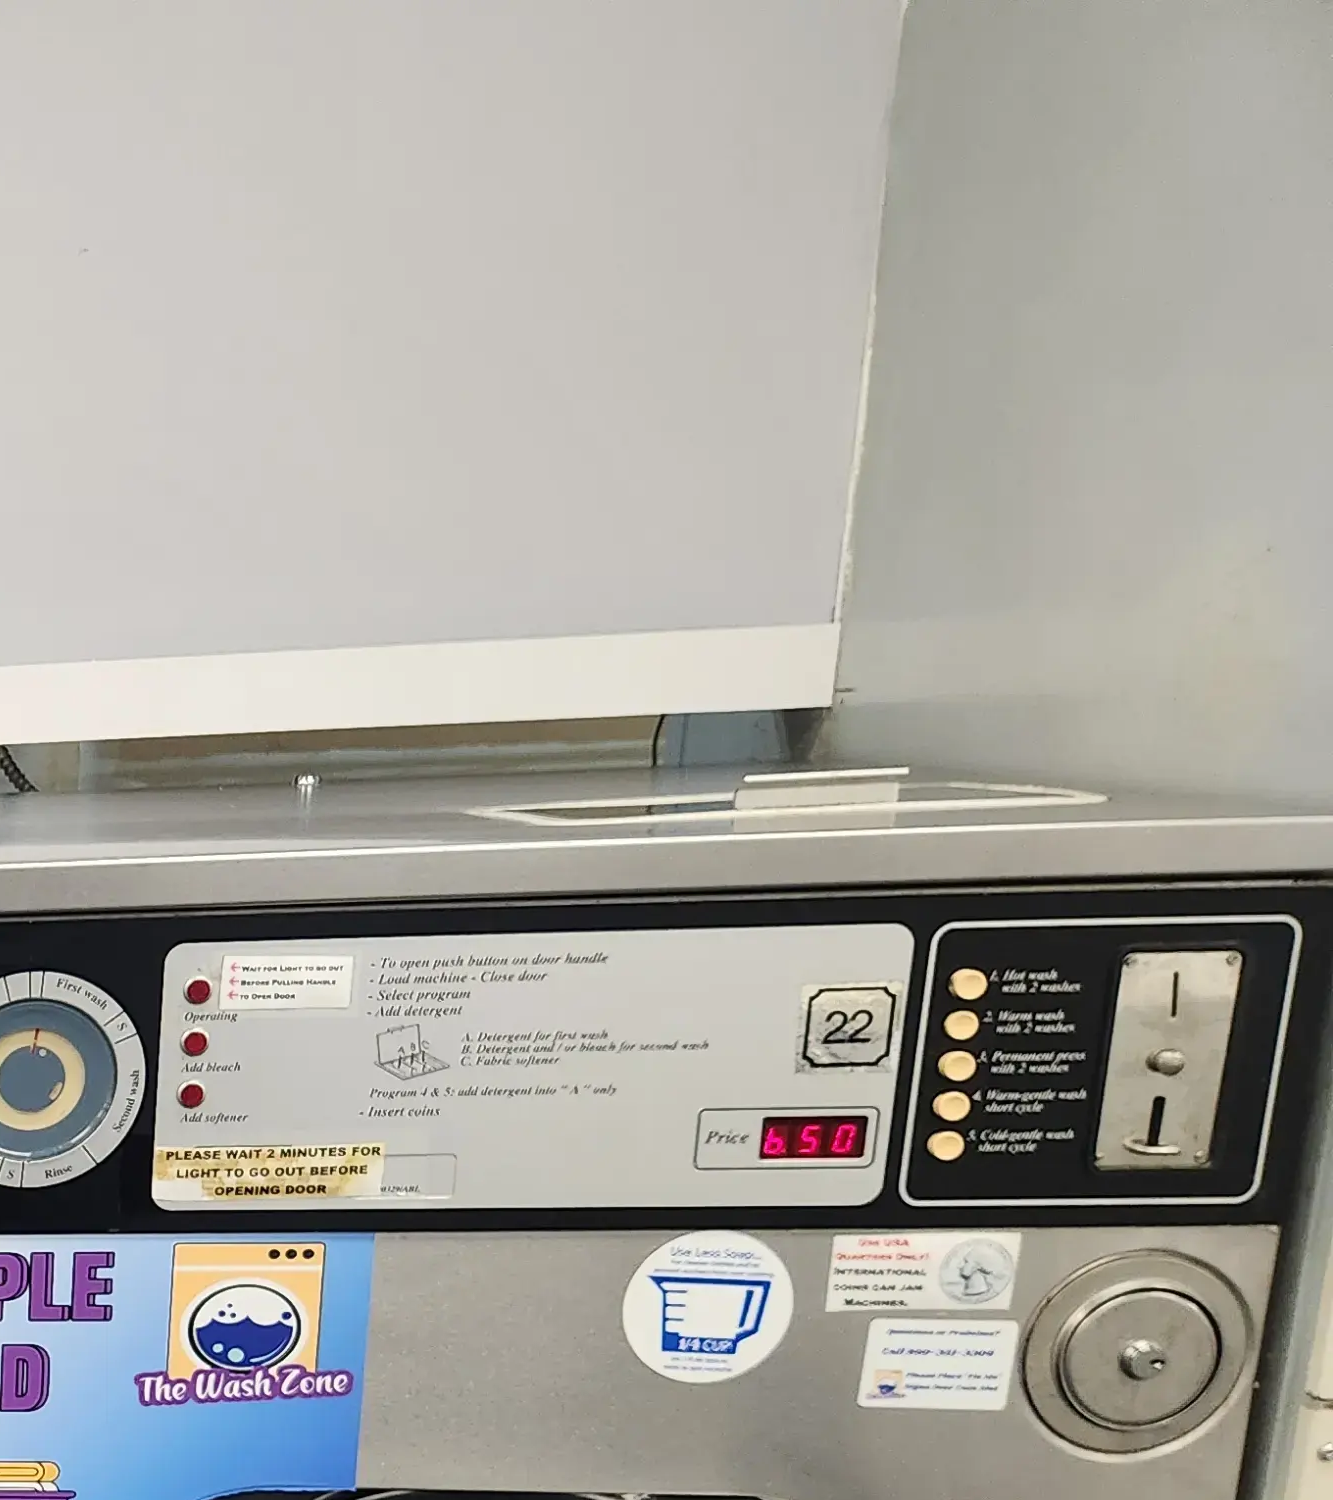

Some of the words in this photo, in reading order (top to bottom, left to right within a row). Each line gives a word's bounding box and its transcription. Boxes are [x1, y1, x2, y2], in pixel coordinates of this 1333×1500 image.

[56, 978, 82, 994] First
[84, 989, 108, 1011] wash
[184, 1012, 238, 1023] Operating
[821, 1010, 874, 1044] 22
[181, 1062, 203, 1073] Add
[206, 1062, 241, 1072] bleach
[180, 1113, 203, 1123] Add
[205, 1113, 249, 1124] softener
[705, 1130, 749, 1144] Price
[166, 1150, 221, 1160] PLEASE
[226, 1149, 262, 1159] WAIT
[267, 1148, 275, 1158] 2
[279, 1147, 346, 1158] MINUTES
[351, 1146, 381, 1156] FOR
[44, 1164, 73, 1179] Rinse
[176, 1168, 219, 1178] LIGHT
[225, 1168, 244, 1178] TO
[249, 1167, 270, 1177] GO
[275, 1167, 305, 1177] OUT
[309, 1165, 368, 1176] BEFORE
[215, 1185, 280, 1196] OPENING
[285, 1184, 327, 1194] DOOR
[138, 1376, 188, 1401] The
[194, 1370, 272, 1398] Wash
[278, 1368, 348, 1396] Zone
